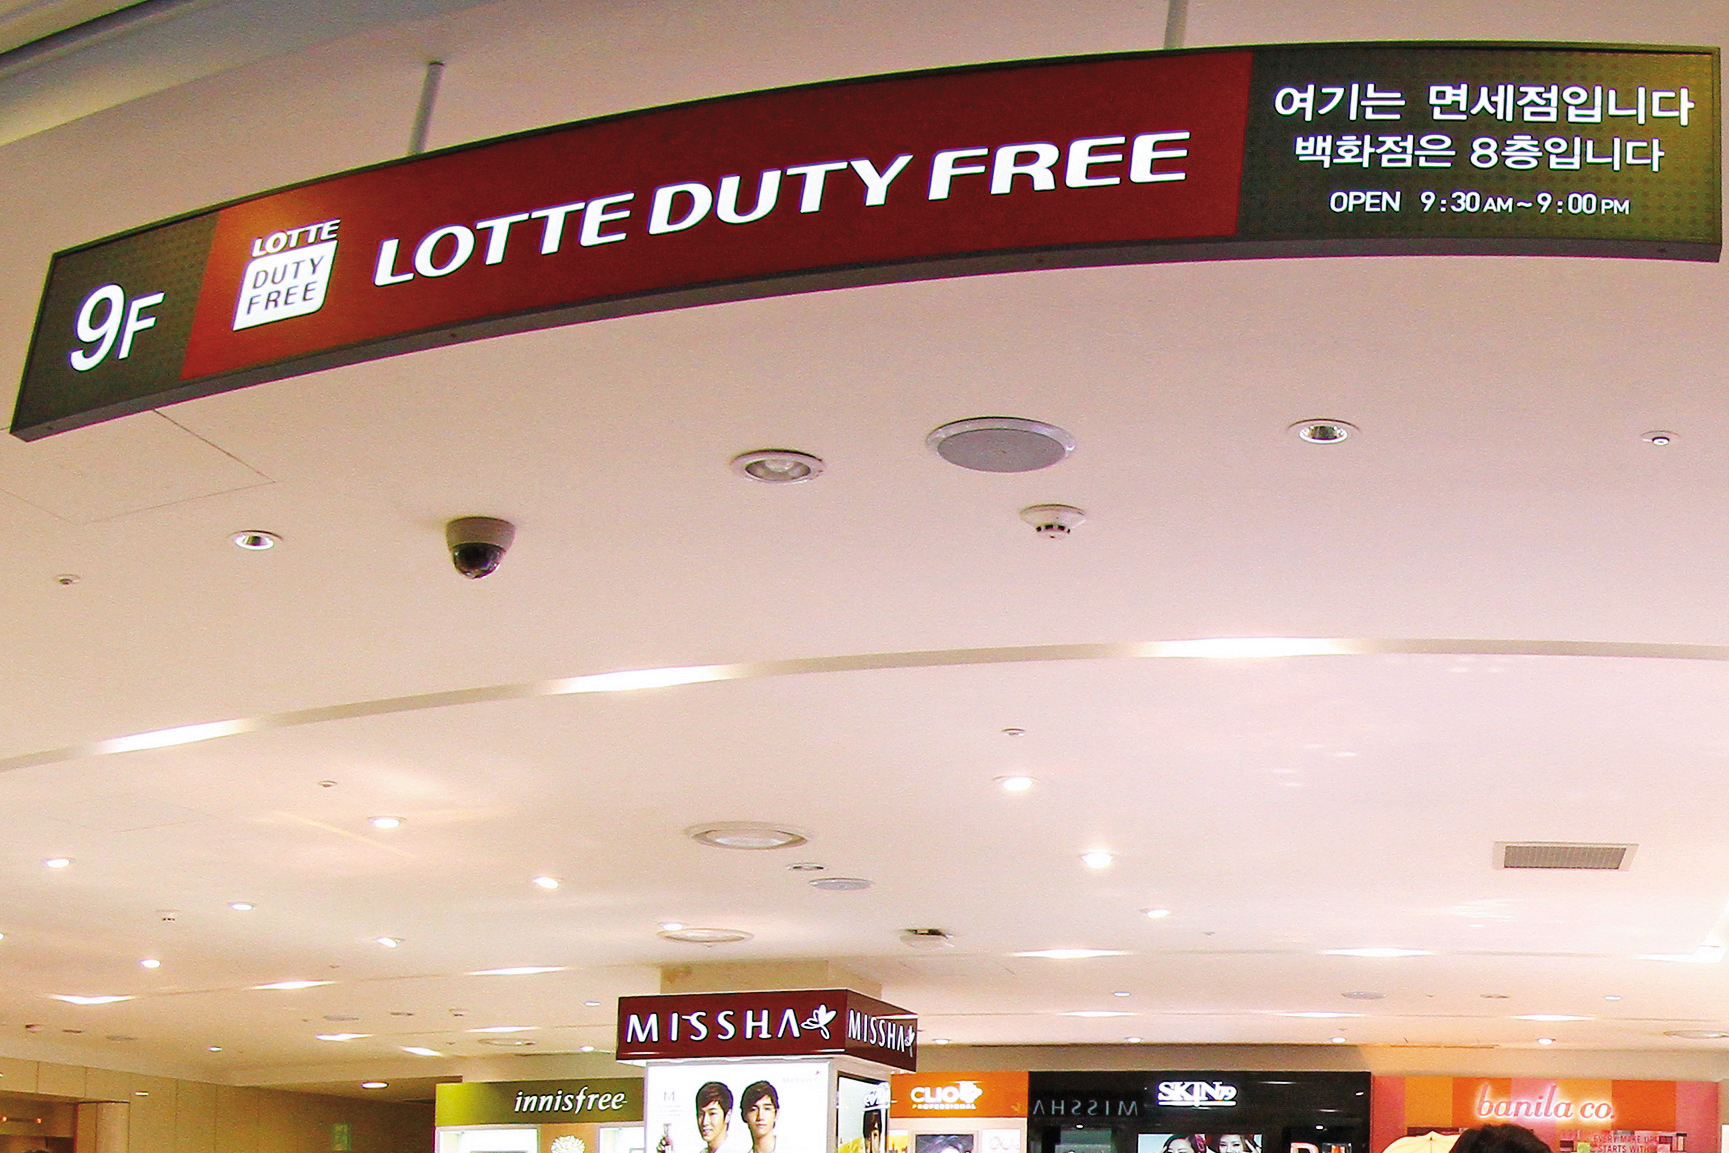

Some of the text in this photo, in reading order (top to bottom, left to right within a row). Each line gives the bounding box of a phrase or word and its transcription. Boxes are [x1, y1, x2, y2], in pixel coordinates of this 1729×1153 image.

[1273, 83, 1694, 127] 여기는 면세점입니다
[1294, 134, 1665, 173] 백화점은 8층입니다
[373, 130, 1191, 287] LOTTE DUTY FREE
[1329, 190, 1401, 215] OPEN
[250, 218, 342, 258] LOTTE
[251, 254, 327, 290] DUTY
[246, 280, 318, 315] FREE
[68, 283, 165, 373] 9F
[626, 1008, 801, 1044] MISSHA
[848, 1009, 905, 1053] MISSHA
[514, 1085, 626, 1114] innisfree
[910, 1085, 960, 1104] CLIO
[1477, 1083, 1616, 1120] banila co.
[1599, 1145, 1627, 1153] STARTS
